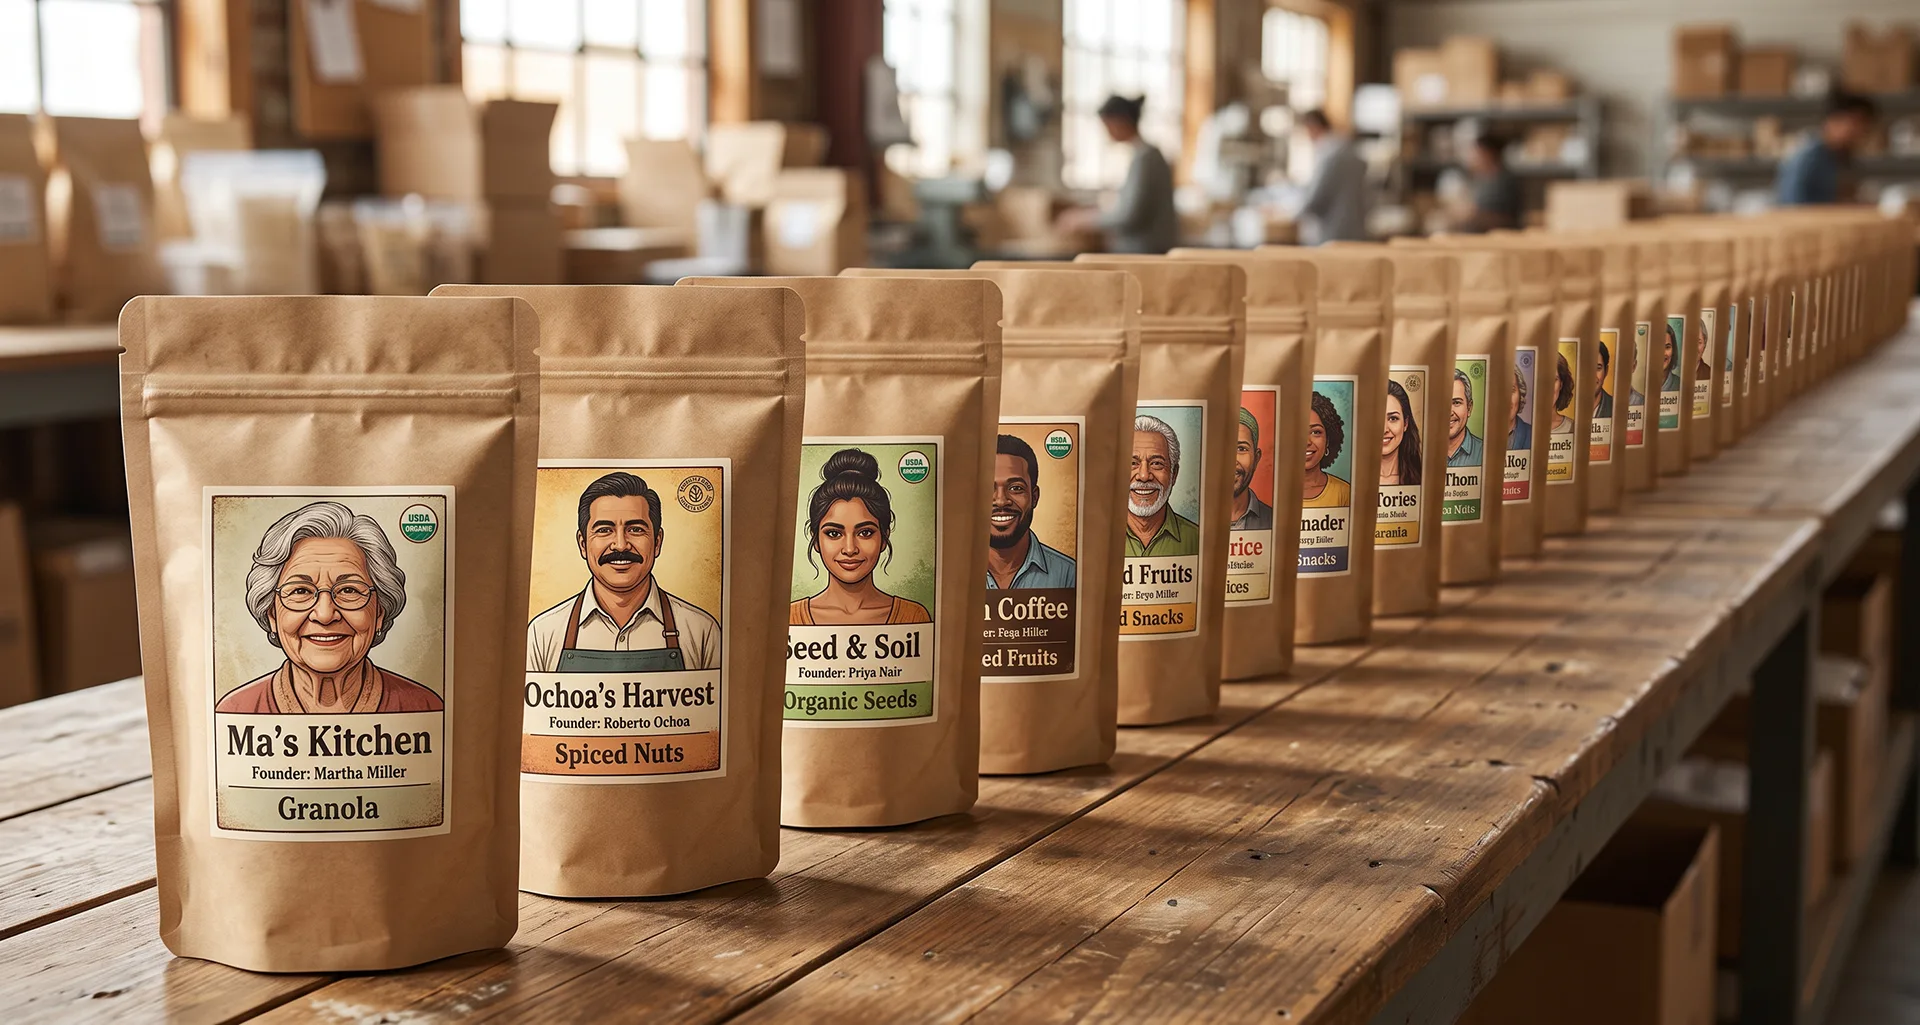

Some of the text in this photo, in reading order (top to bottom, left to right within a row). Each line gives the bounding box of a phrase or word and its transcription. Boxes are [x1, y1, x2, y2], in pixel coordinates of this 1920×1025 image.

[905, 458, 923, 466] USDA
[408, 513, 430, 523] USDA
[1230, 536, 1263, 556] rice
[1139, 562, 1193, 585] Fruits
[1155, 589, 1179, 599] Miller
[1226, 580, 1249, 594] ices
[997, 596, 1069, 621] Coffee
[1132, 608, 1184, 627] Snacks
[845, 634, 868, 660] &
[874, 631, 921, 660] Soil
[1007, 648, 1058, 667] Fruits
[798, 665, 903, 681] Founder: Priya Nair
[523, 681, 715, 709] Ochoa's Harvest
[783, 688, 917, 716] Organic Seeds
[549, 715, 690, 730] Founder: Roberto Ochoa
[226, 723, 433, 758] Ma's Kitchen
[555, 742, 685, 770] Spiced Nuts
[251, 764, 407, 781] Founder: Martha Miller
[277, 795, 380, 821] Granola
